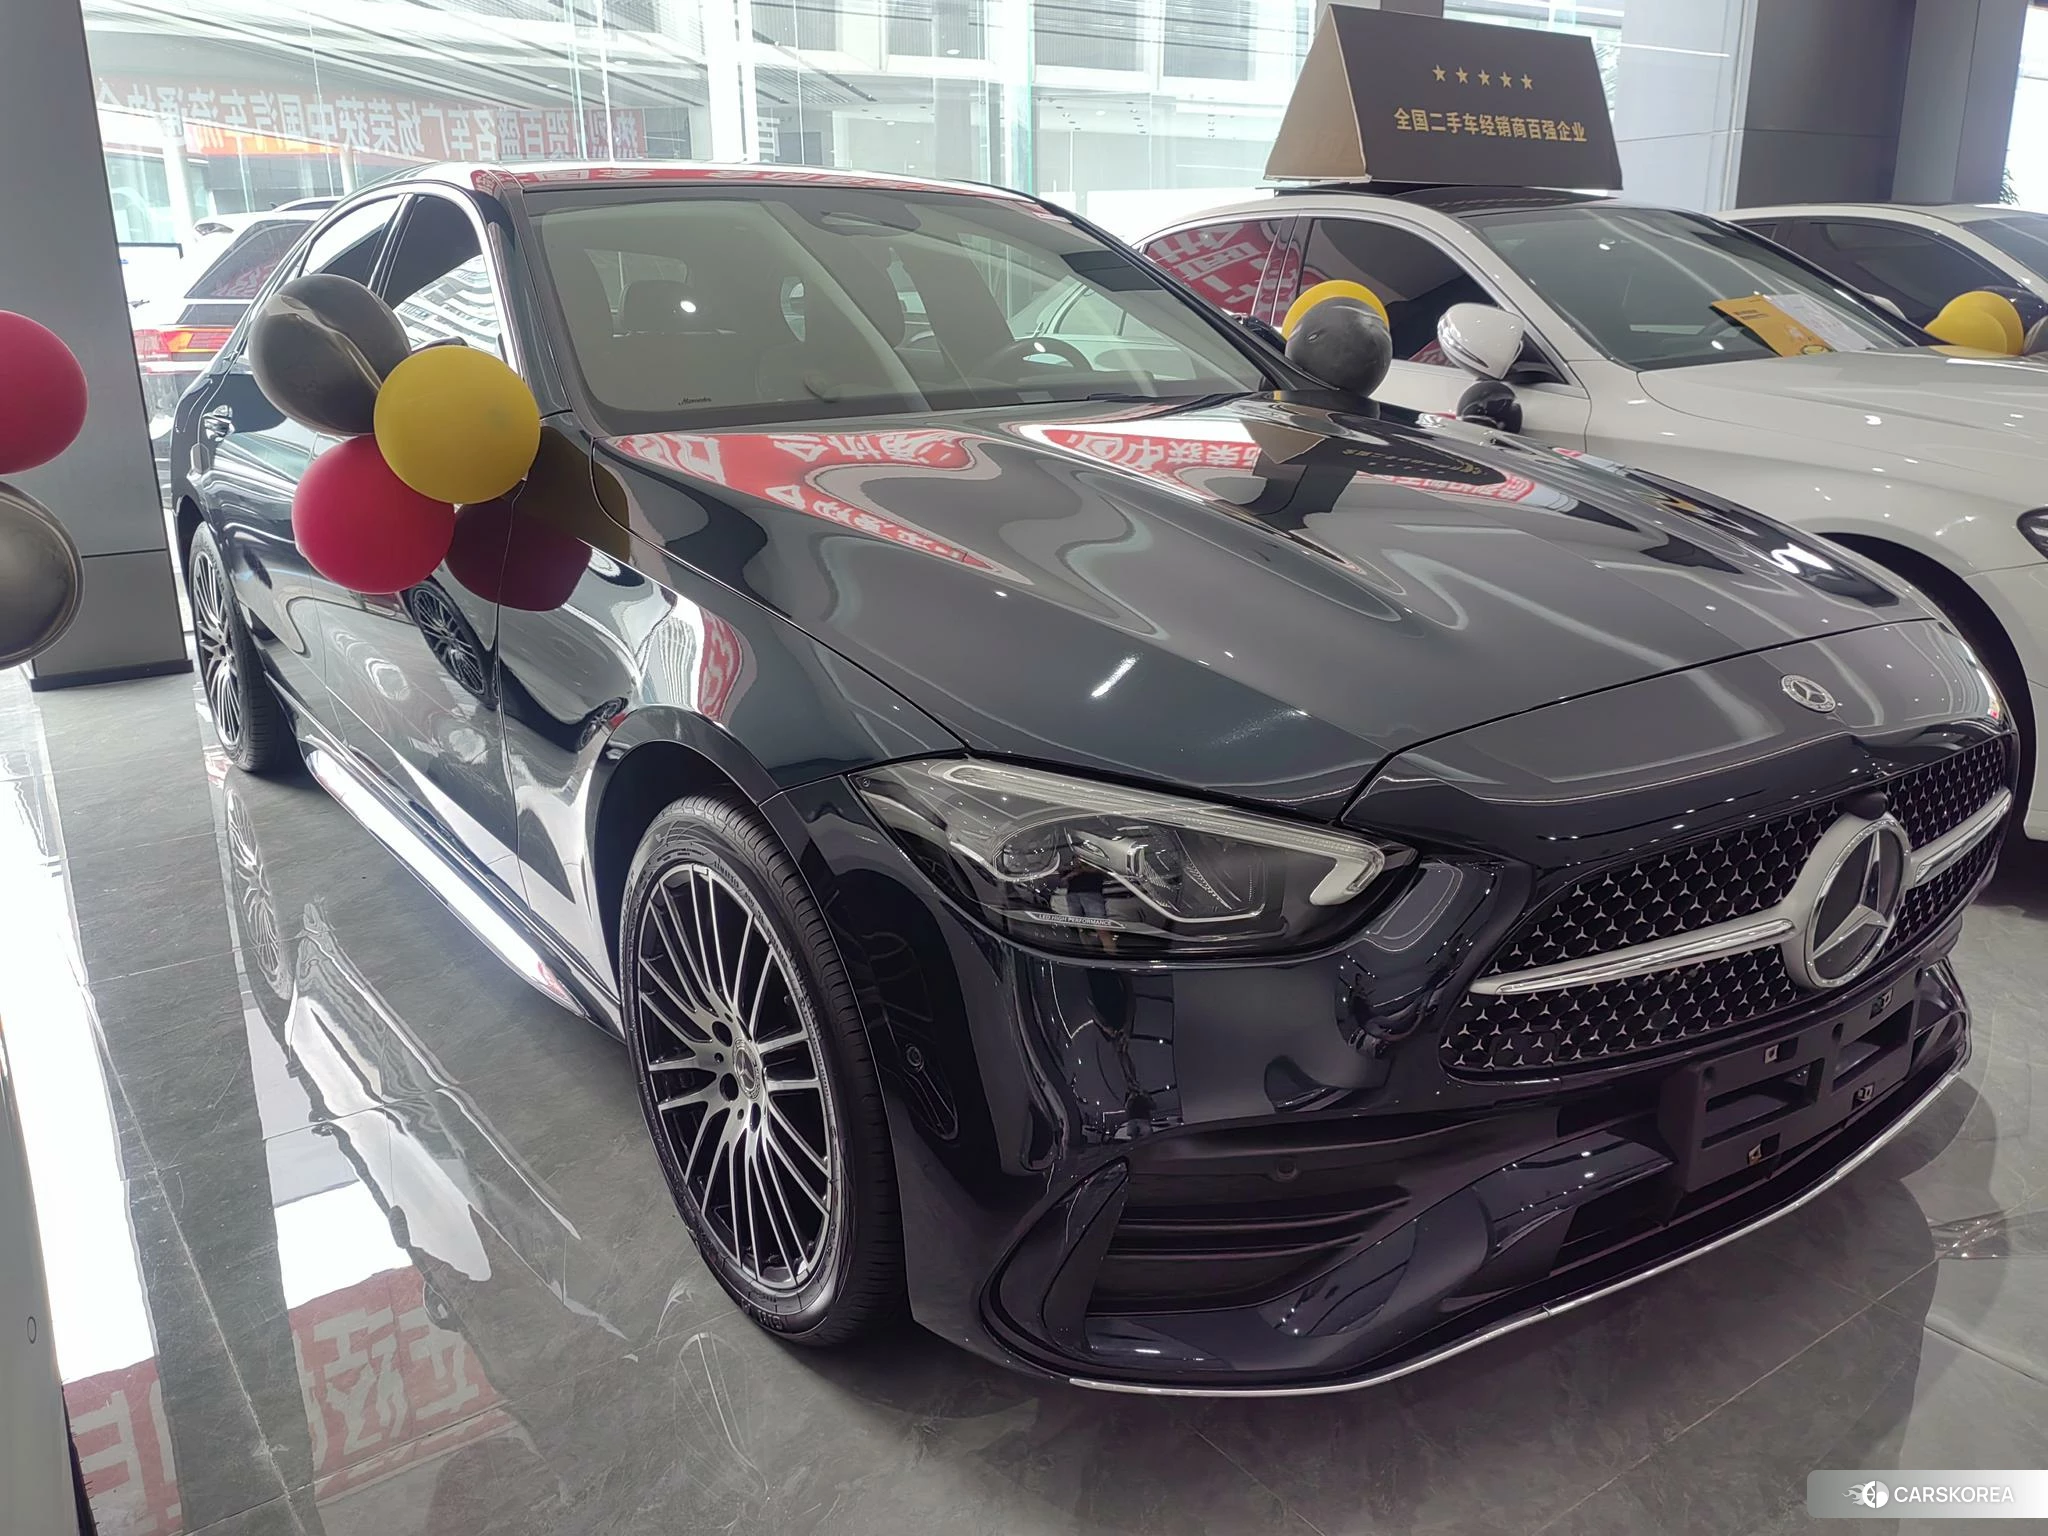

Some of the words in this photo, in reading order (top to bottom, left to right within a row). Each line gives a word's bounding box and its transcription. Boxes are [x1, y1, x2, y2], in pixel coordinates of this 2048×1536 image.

[1393, 107, 1588, 143] 全国二手车经销商百强企业
[1068, 917, 1112, 926] PERFORMANCE
